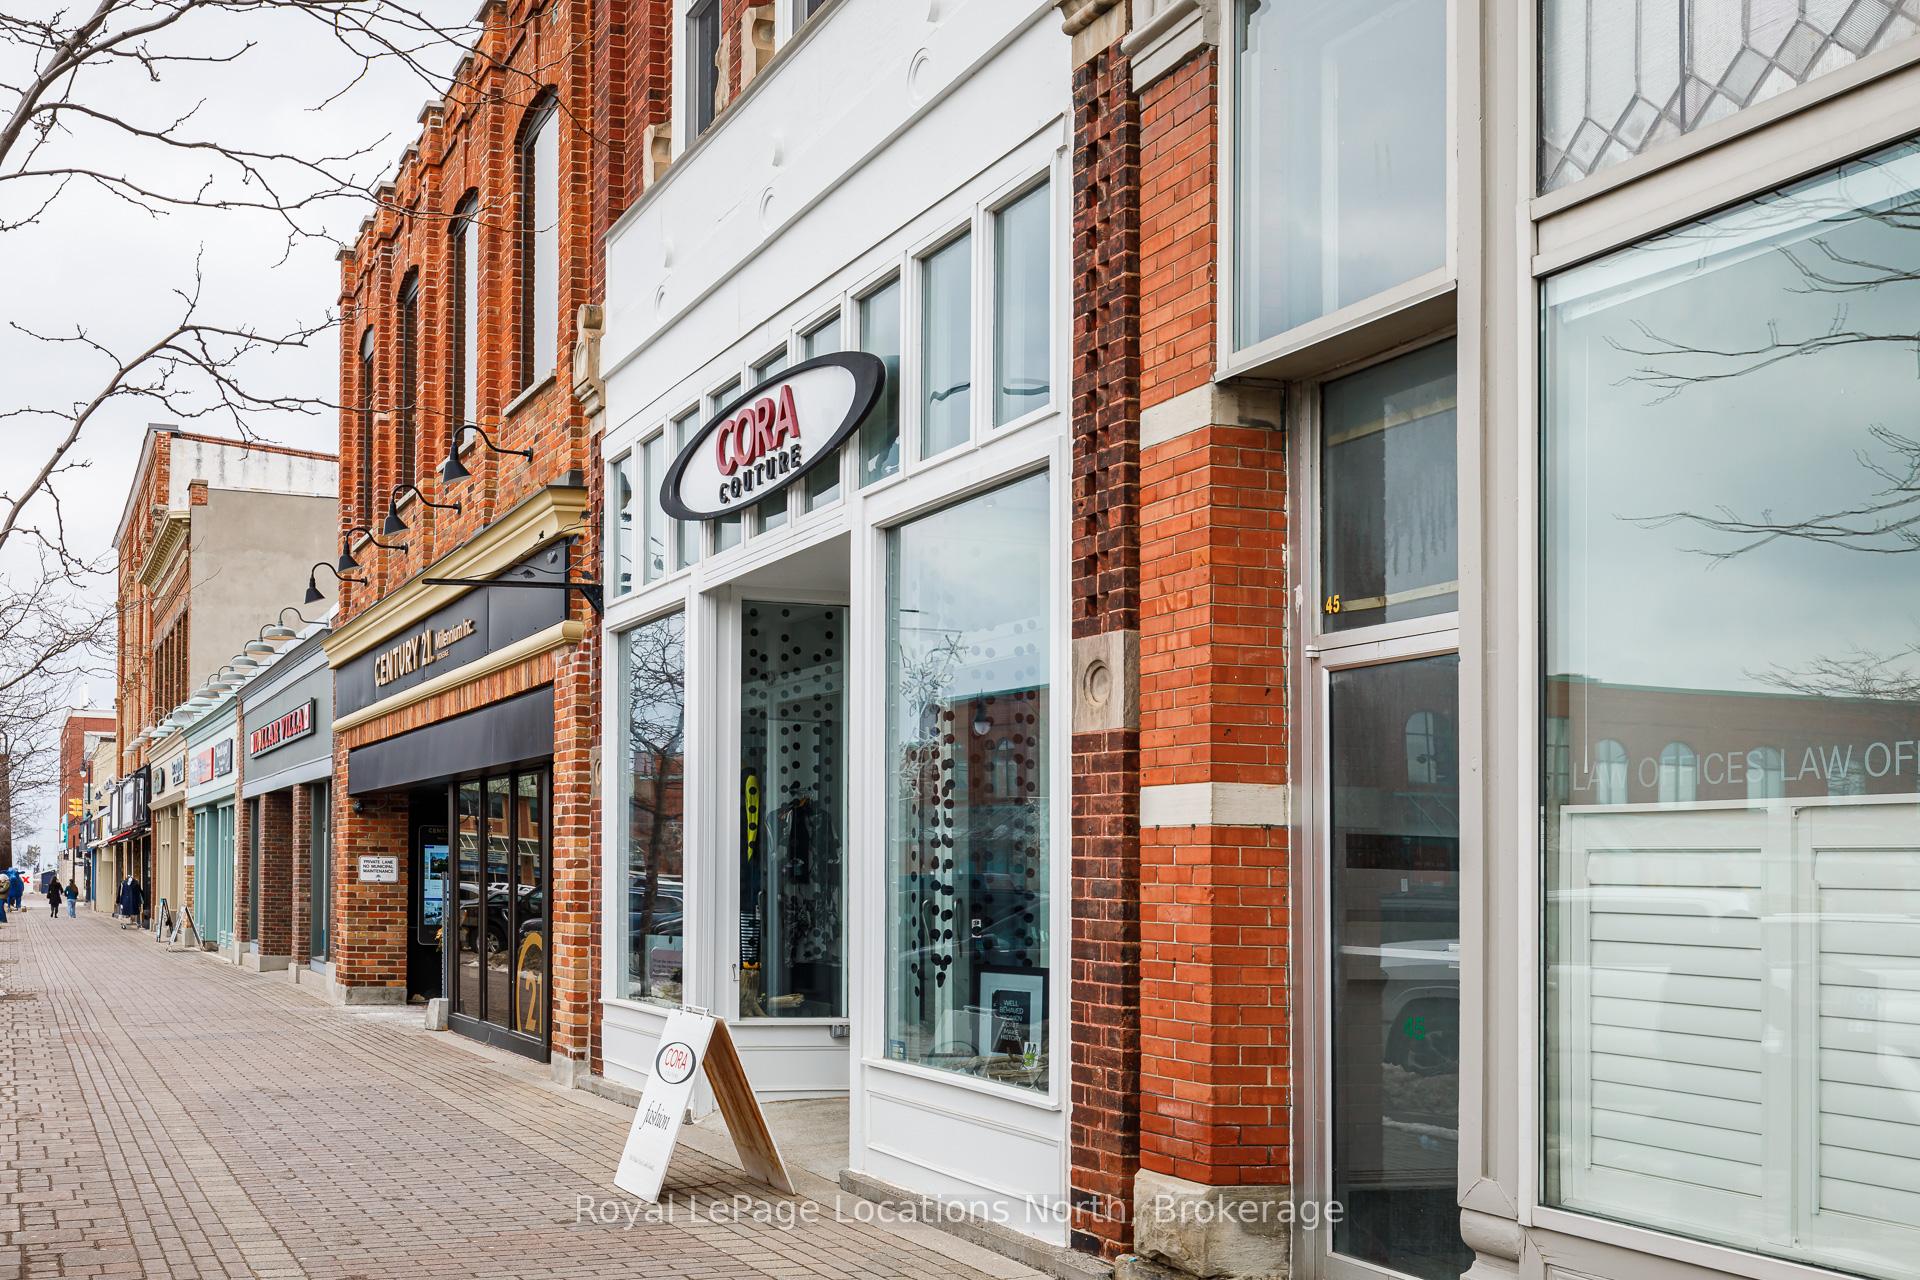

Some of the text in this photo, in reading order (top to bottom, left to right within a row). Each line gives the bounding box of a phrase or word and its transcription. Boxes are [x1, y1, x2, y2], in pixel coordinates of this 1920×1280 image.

[716, 385, 800, 475] CORA
[719, 443, 802, 504] COUTURE
[1325, 594, 1341, 614] 45
[374, 635, 420, 687] CENTURY
[280, 708, 304, 740] VILLA
[1780, 744, 1853, 781] LAW
[1864, 740, 1920, 778] OF
[1403, 1016, 1425, 1040] 45
[664, 1048, 688, 1070] CORA
[638, 1100, 671, 1130] fashion
